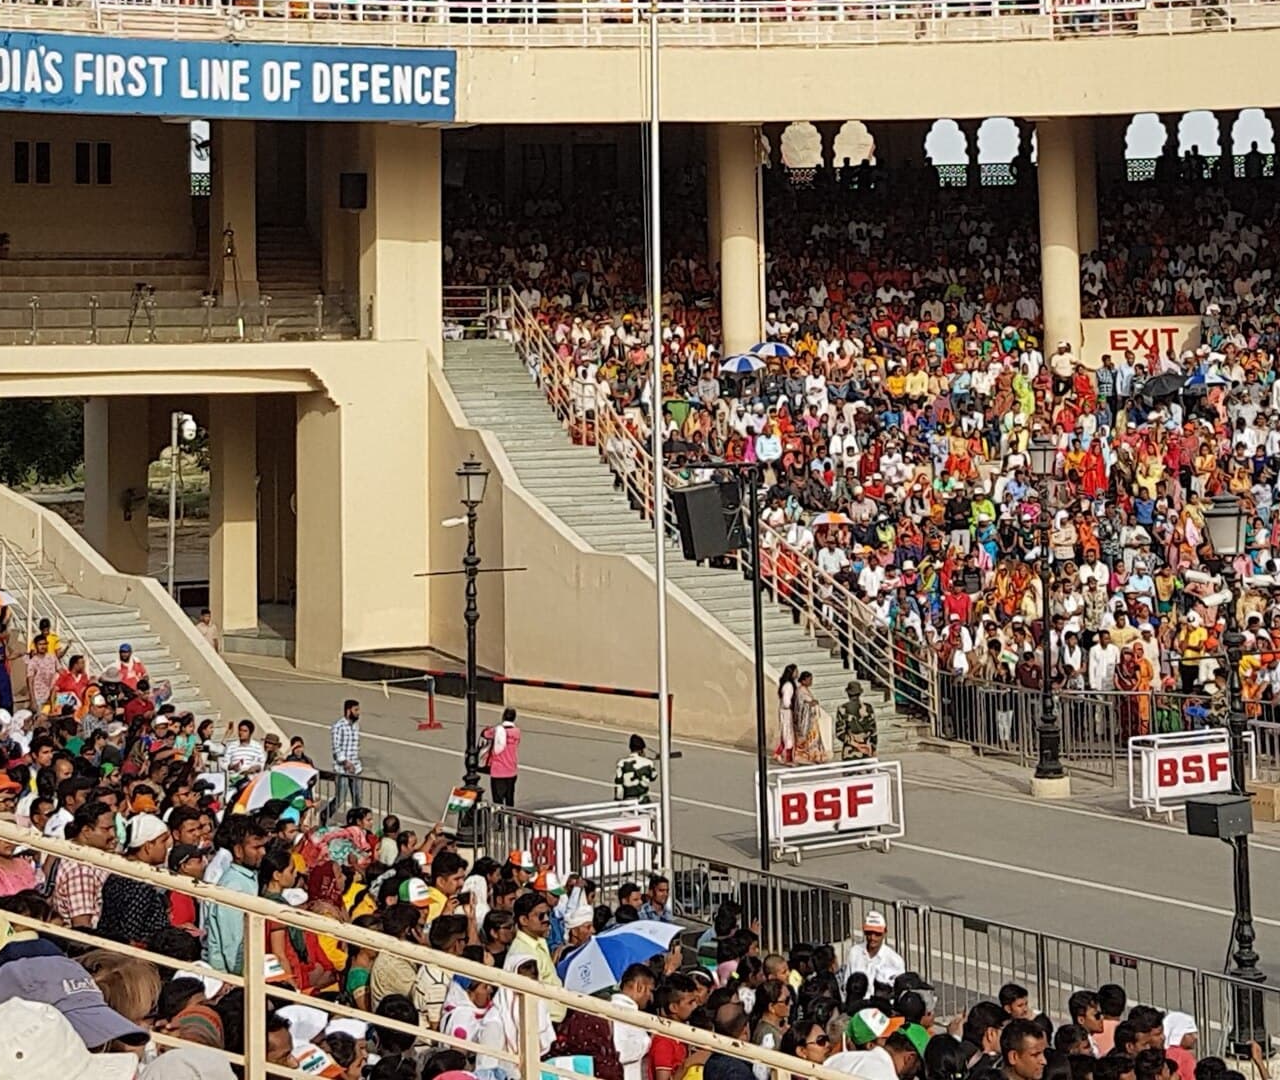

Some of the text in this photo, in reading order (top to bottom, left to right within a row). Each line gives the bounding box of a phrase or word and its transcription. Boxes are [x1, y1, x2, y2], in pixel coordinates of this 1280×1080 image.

[74, 52, 168, 97] FIRST
[180, 58, 250, 102] LINE
[262, 60, 301, 102] OF
[312, 62, 451, 105] DEFENCE
[1109, 327, 1179, 352] EXIT
[1158, 751, 1229, 788] BSF
[781, 783, 874, 826] BSF
[532, 825, 641, 872] BSF
